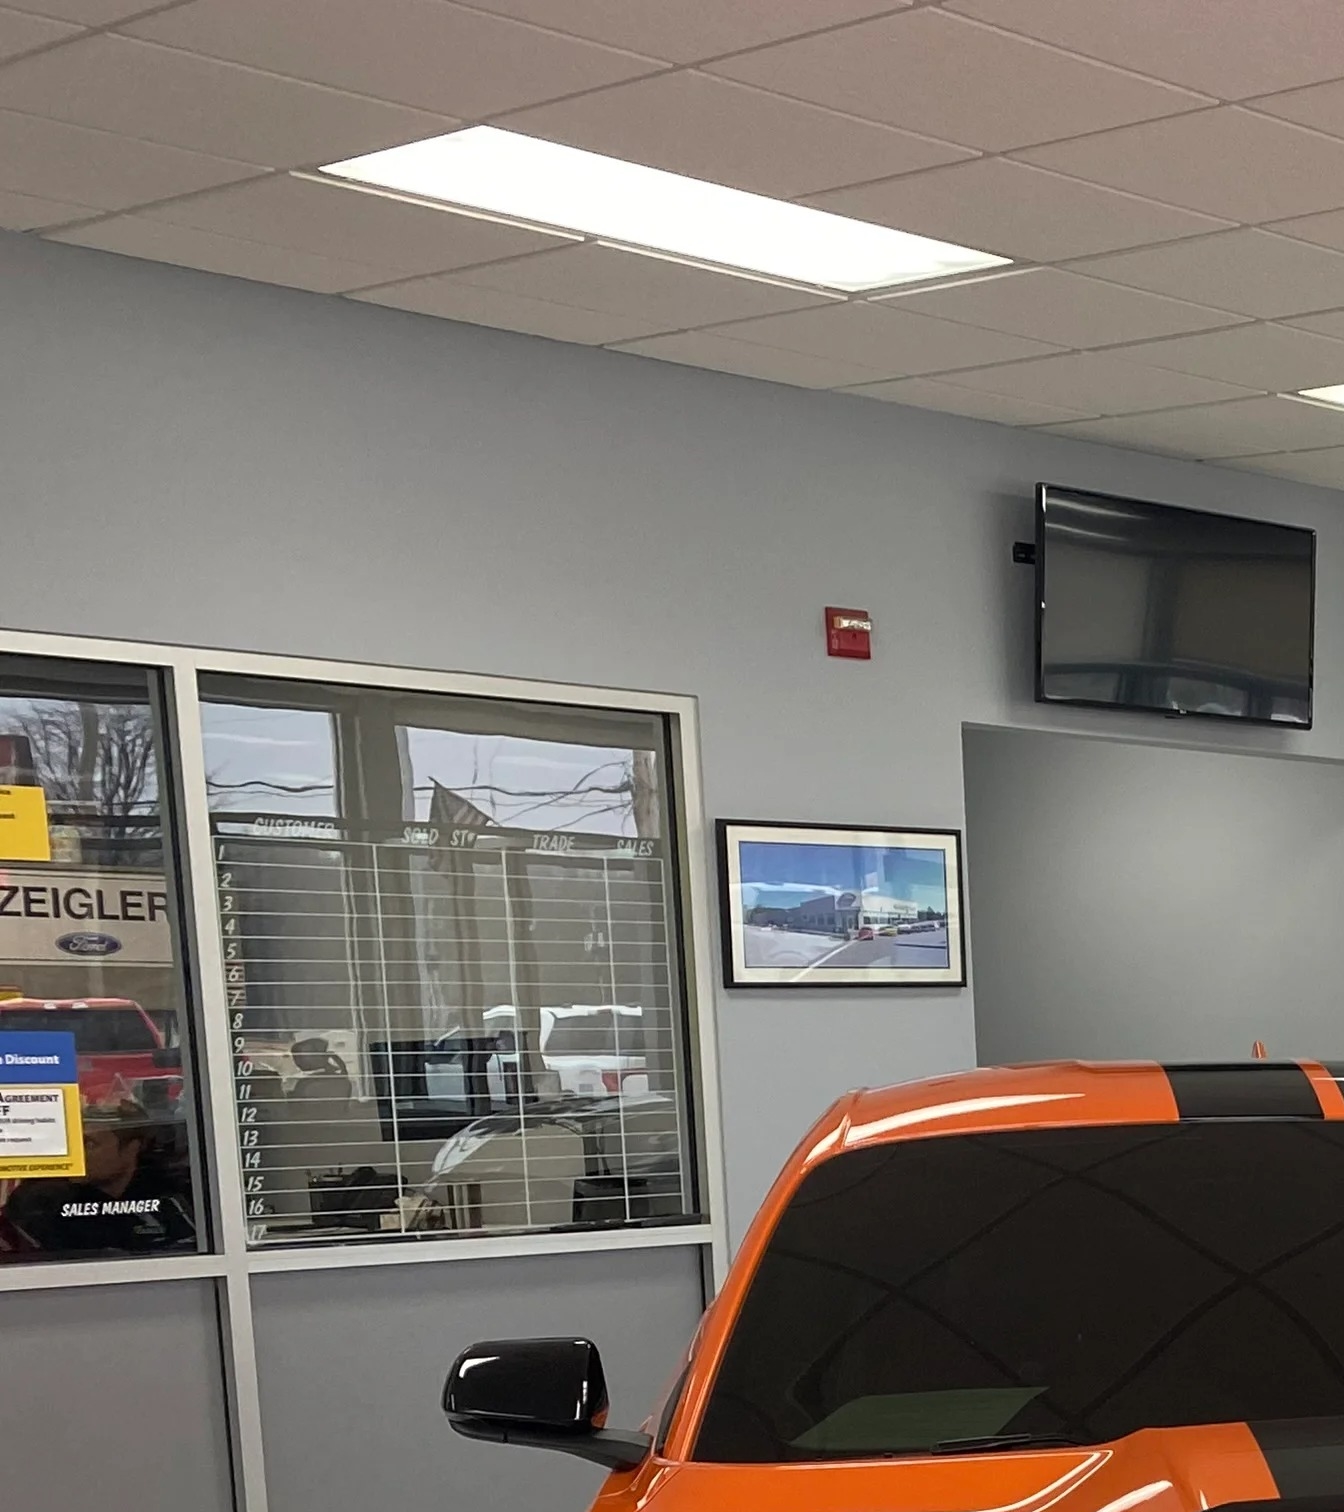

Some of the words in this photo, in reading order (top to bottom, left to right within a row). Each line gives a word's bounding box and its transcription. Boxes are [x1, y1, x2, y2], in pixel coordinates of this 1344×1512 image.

[253, 817, 336, 838] CUSTOMER
[402, 826, 438, 845] SOLD
[532, 833, 576, 851] TRADE
[617, 840, 655, 856] SALES
[218, 844, 225, 860] 1
[220, 873, 232, 887] 2
[0, 886, 168, 921] ZEIGLER
[223, 896, 233, 911] 3
[224, 918, 235, 934] 4
[226, 943, 237, 960] 5
[228, 966, 239, 981] 6
[228, 990, 241, 1006] 7
[232, 1013, 244, 1029] 8
[234, 1037, 245, 1053] 9
[5, 1054, 60, 1065] Discount
[237, 1061, 253, 1076] 10
[239, 1084, 251, 1099] 11
[241, 1107, 257, 1122] 12
[243, 1130, 259, 1146] 13
[245, 1152, 261, 1168] 14
[247, 1176, 264, 1192] 15
[61, 1202, 99, 1217] SALES
[101, 1199, 160, 1215] MANAGER
[249, 1199, 264, 1215] 16
